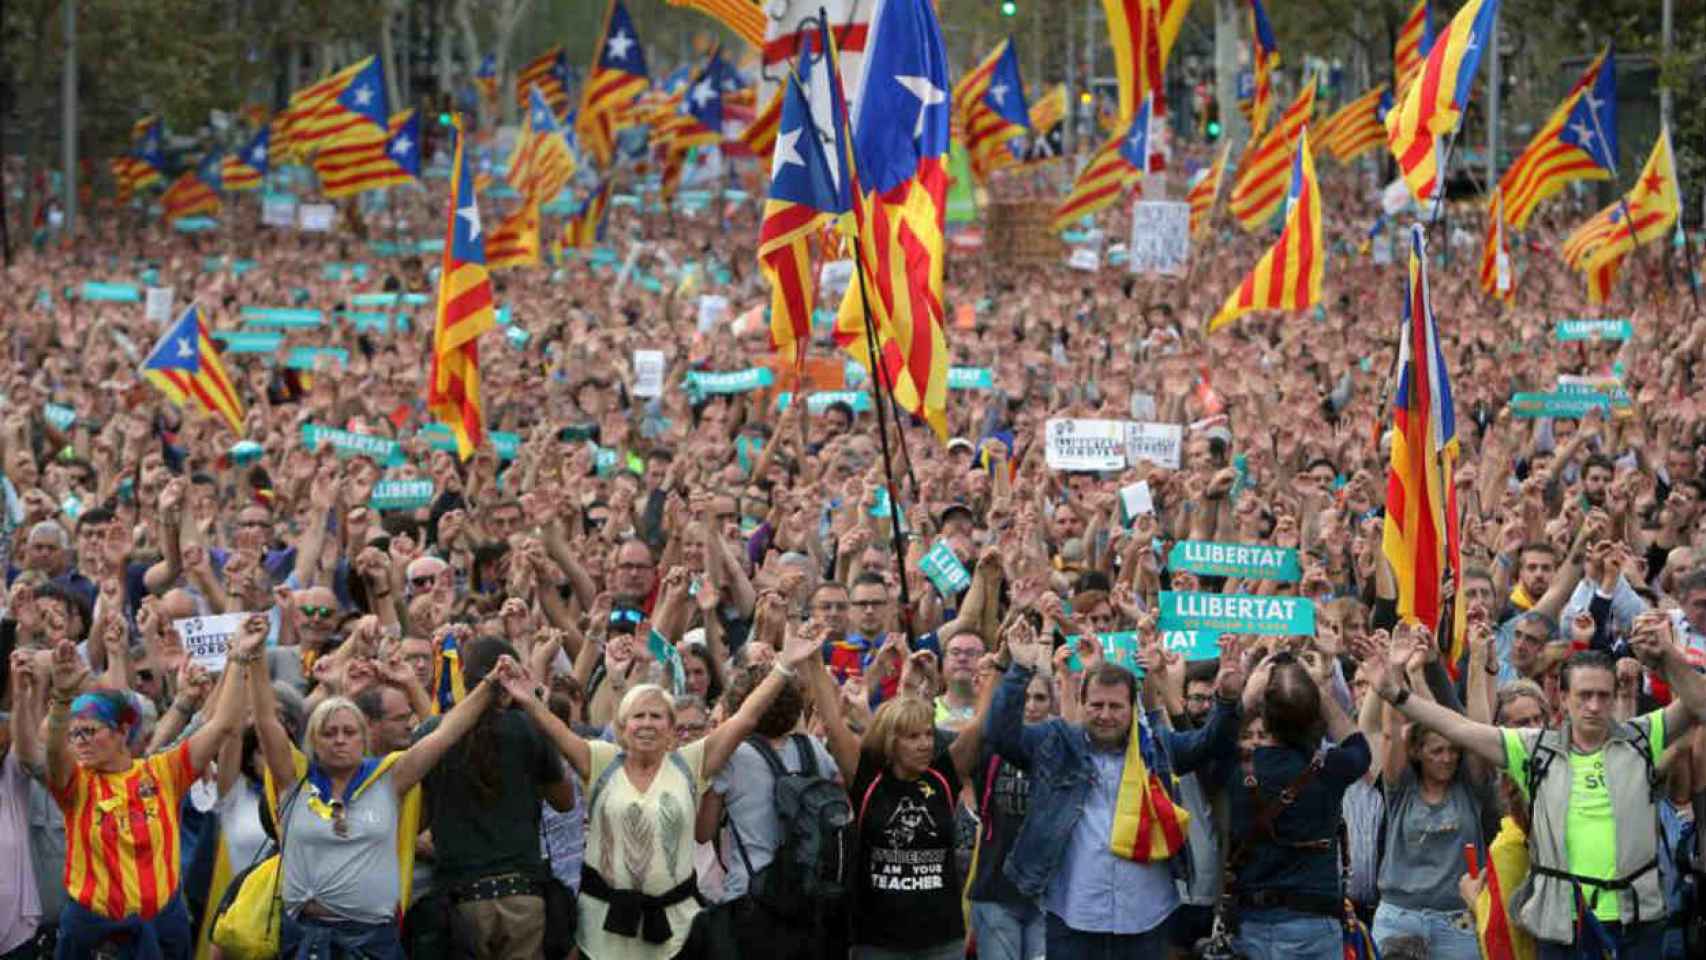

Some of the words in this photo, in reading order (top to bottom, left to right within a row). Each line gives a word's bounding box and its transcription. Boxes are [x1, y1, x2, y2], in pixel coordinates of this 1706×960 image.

[1184, 542, 1286, 567] LLIBERTAT
[1176, 595, 1296, 619] LLIBERTAT
[883, 864, 902, 874] AM
[871, 873, 943, 890] TEACHER
